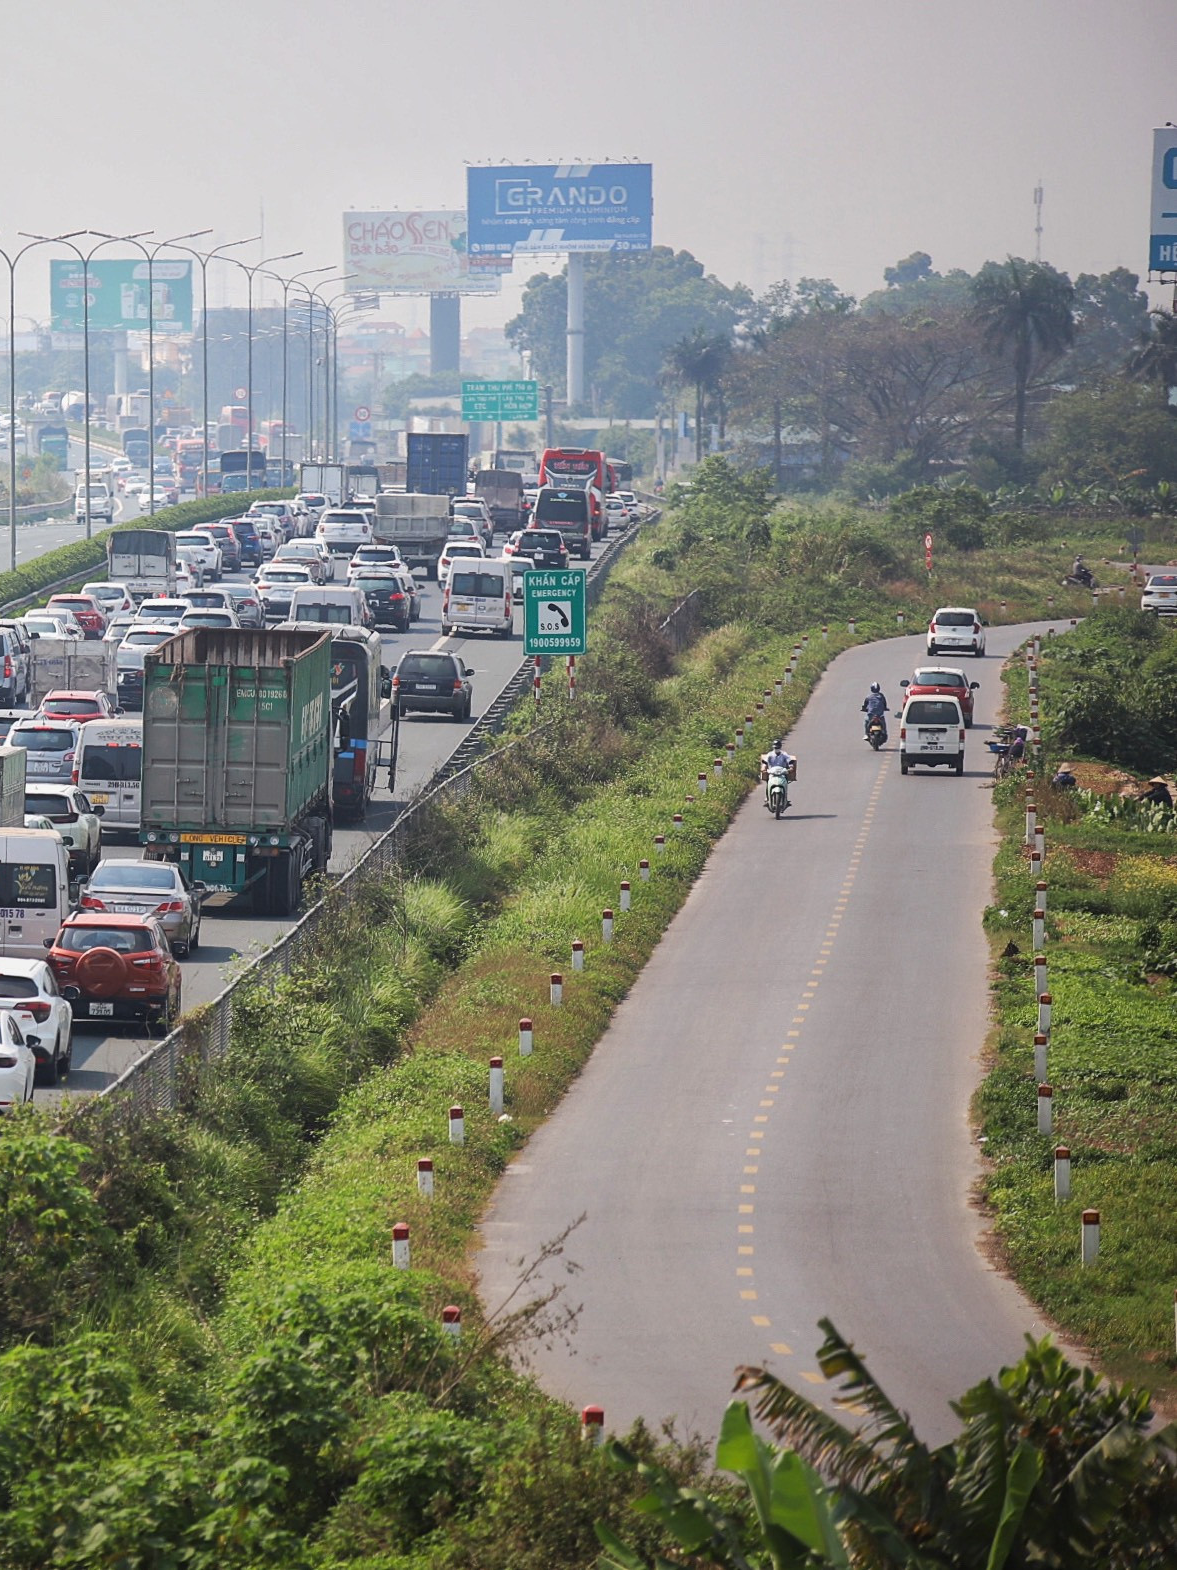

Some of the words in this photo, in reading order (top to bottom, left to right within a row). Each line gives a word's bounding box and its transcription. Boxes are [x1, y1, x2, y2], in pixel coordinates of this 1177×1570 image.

[507, 185, 627, 206] GRANDO
[561, 572, 581, 586] CẤP
[532, 589, 577, 597] EMERGENCY
[529, 637, 581, 647] 1900599959
[236, 689, 256, 698] EMCU
[184, 834, 203, 843] LONG
[209, 835, 244, 844] VEHICLE
